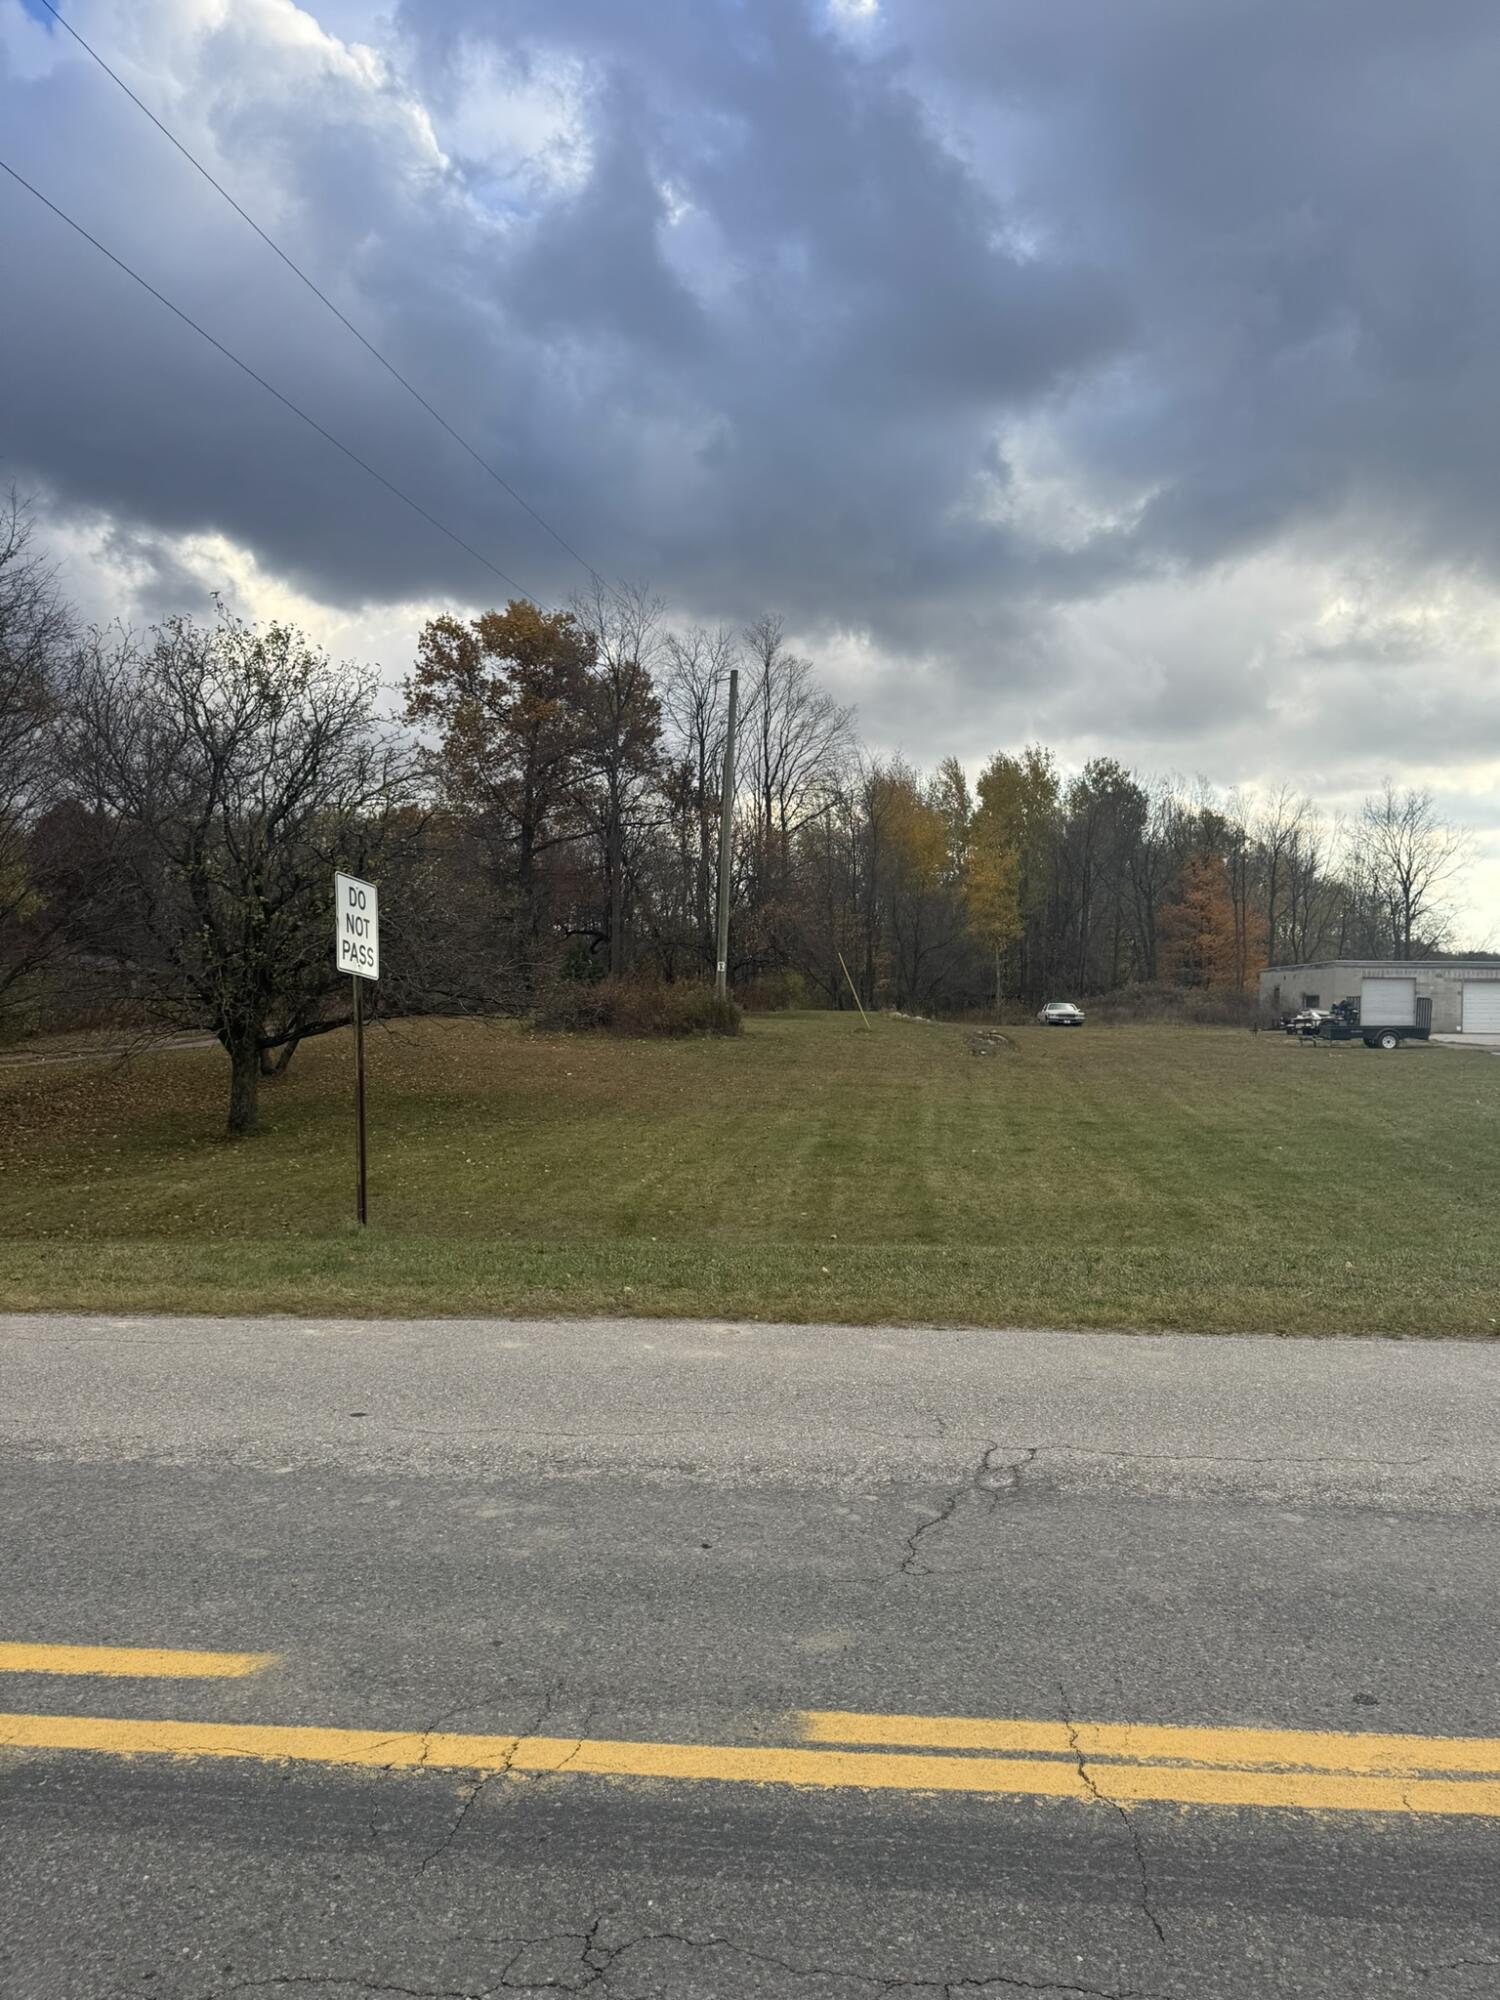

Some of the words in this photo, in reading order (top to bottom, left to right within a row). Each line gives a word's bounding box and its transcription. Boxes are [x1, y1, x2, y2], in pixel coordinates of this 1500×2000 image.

[348, 886, 366, 910] DO
[346, 913, 370, 939] NOT
[342, 939, 374, 967] PASS
